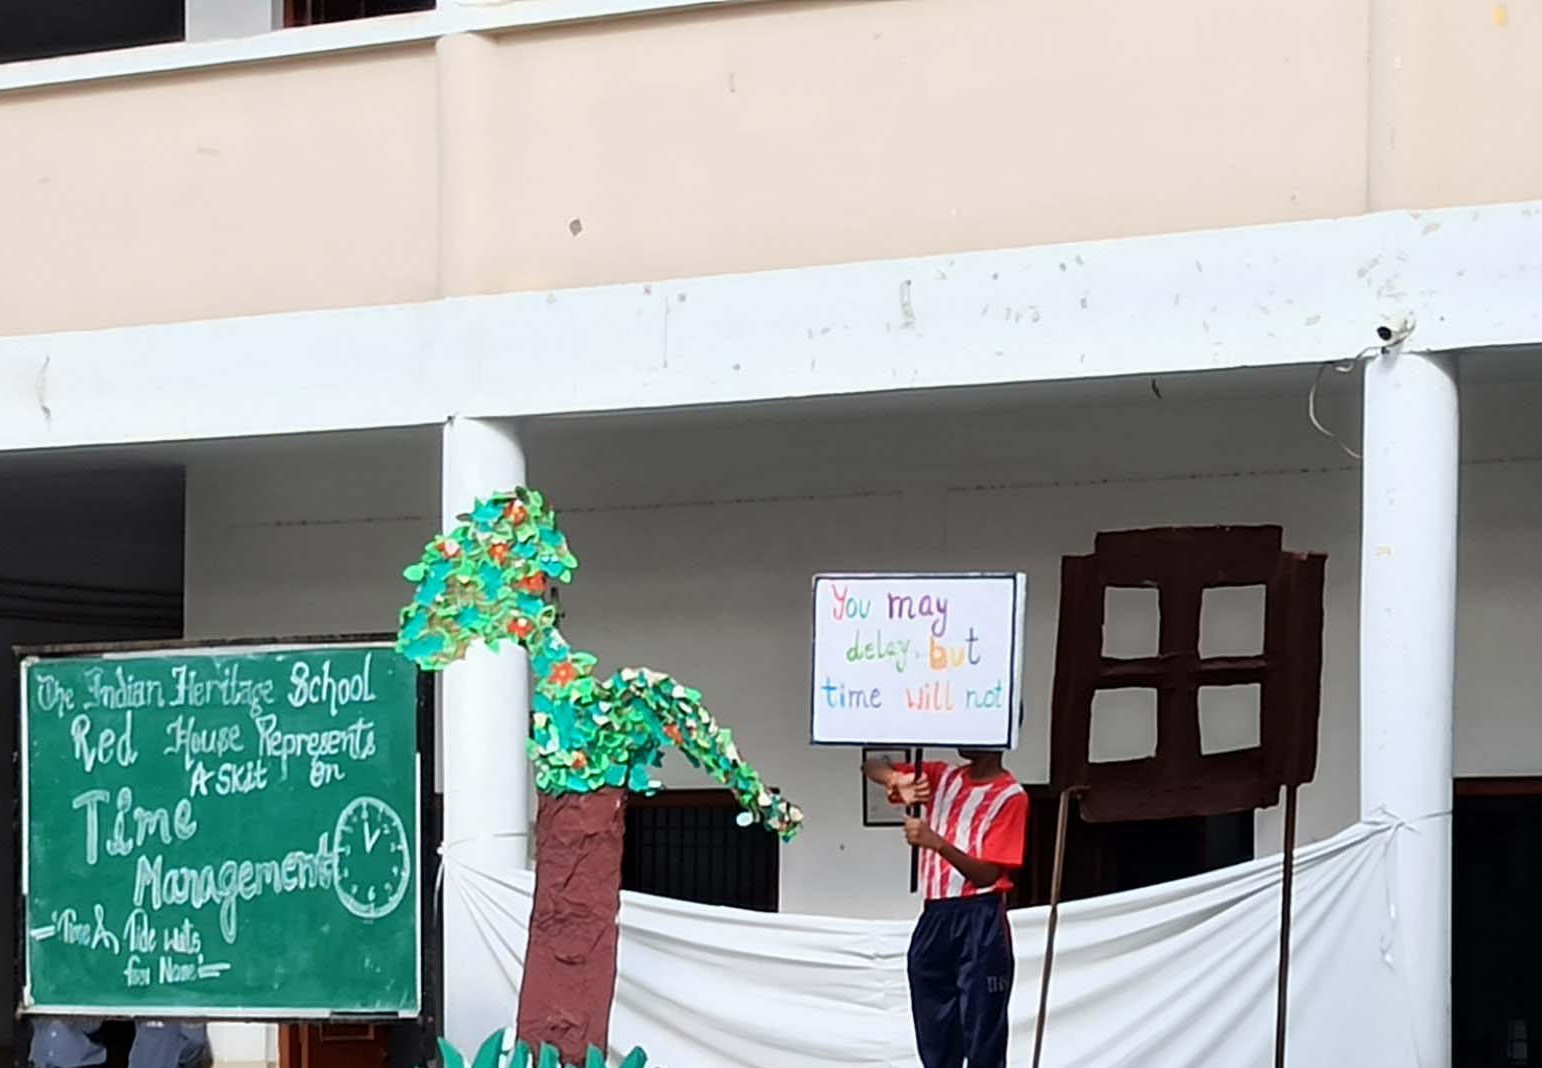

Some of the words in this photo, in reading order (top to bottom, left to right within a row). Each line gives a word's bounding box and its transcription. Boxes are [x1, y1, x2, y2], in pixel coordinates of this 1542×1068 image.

[832, 584, 871, 620] You
[888, 593, 947, 637] may
[929, 627, 981, 670] but
[36, 675, 75, 718] The
[84, 666, 165, 709] Indian
[170, 664, 274, 719] Heritage
[288, 652, 377, 717] School
[821, 676, 882, 708] time
[906, 682, 954, 711] will
[966, 680, 1002, 708] not
[71, 710, 139, 773] Red
[163, 715, 244, 771] House
[256, 714, 376, 781] Represents
[190, 762, 215, 797] A
[73, 787, 197, 864] Time
[134, 832, 335, 944] Management
